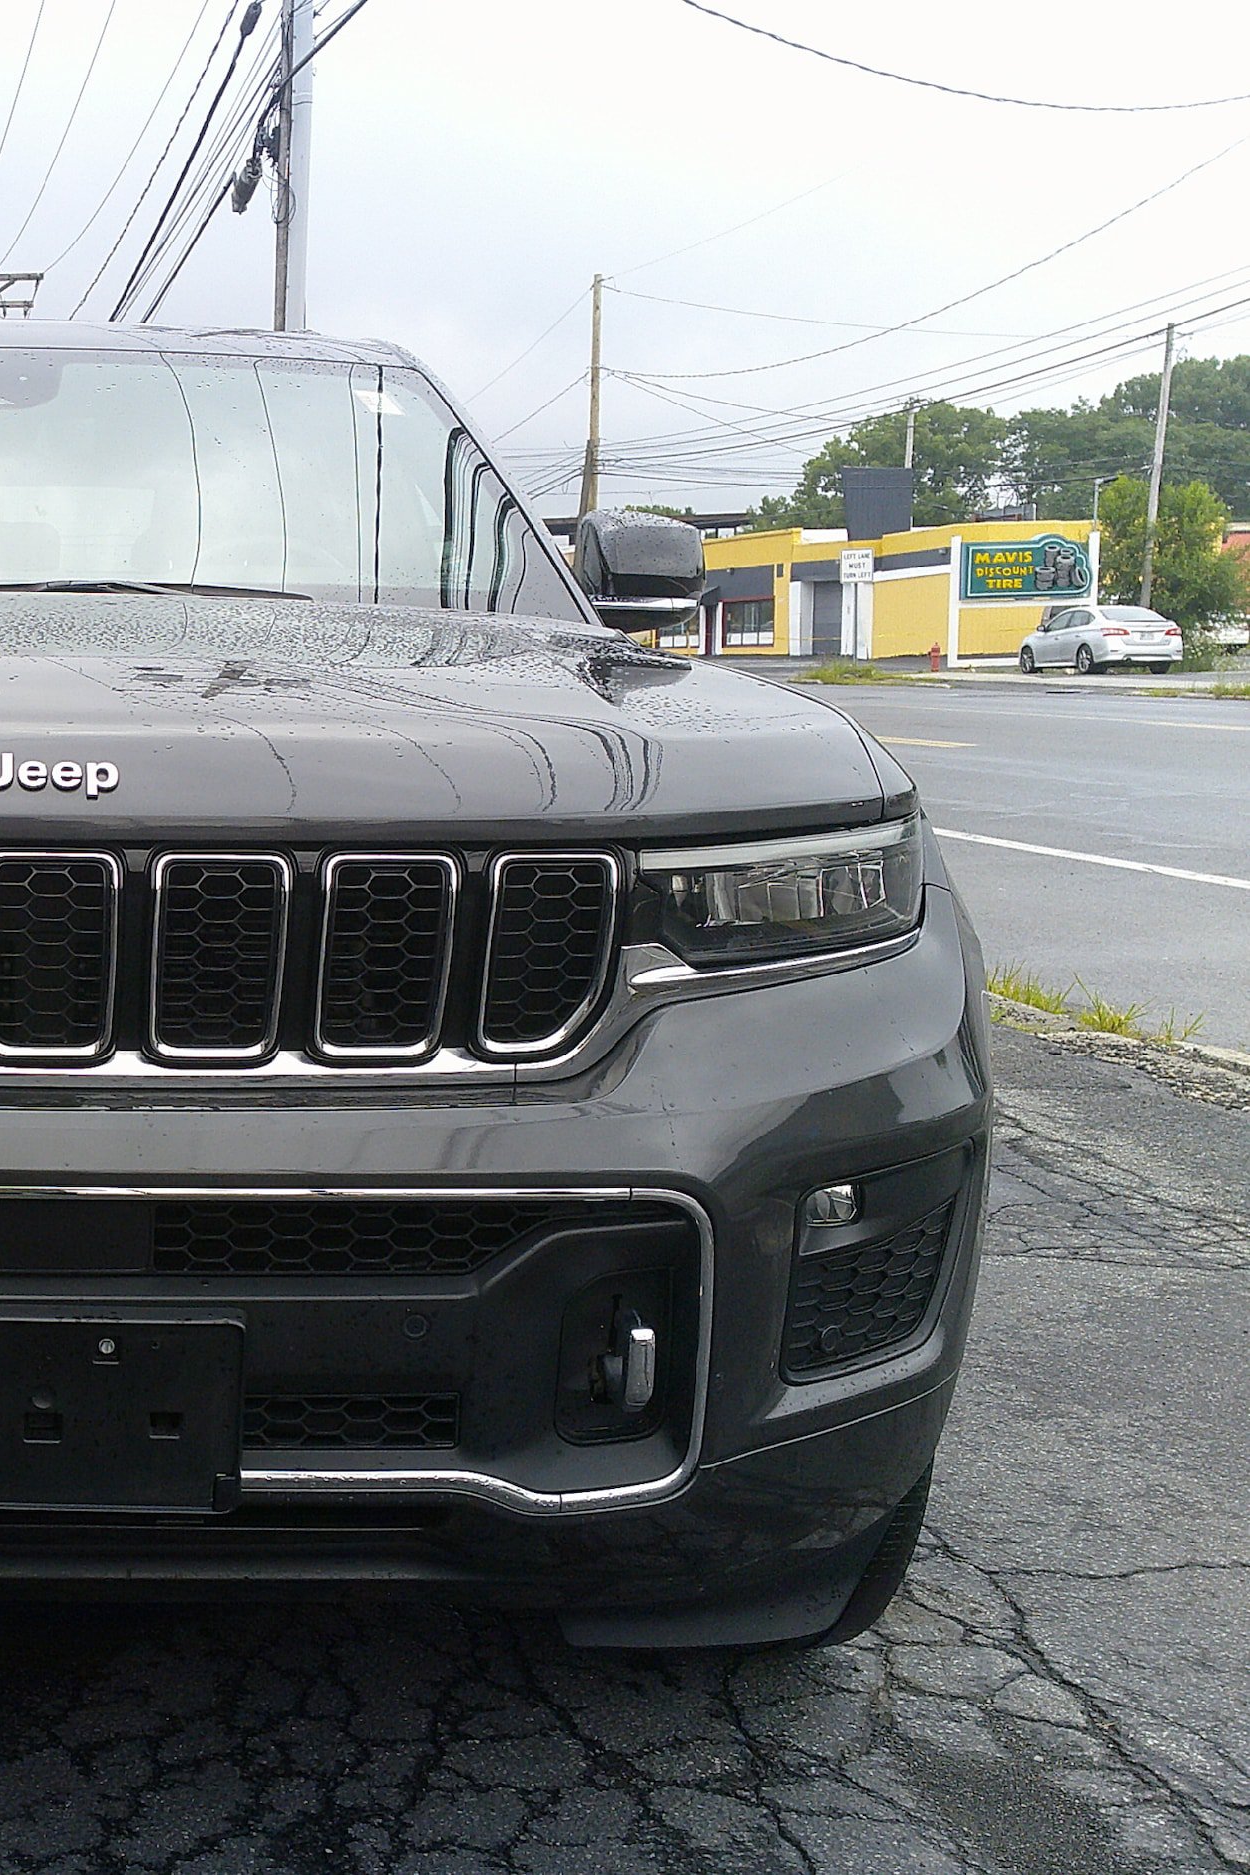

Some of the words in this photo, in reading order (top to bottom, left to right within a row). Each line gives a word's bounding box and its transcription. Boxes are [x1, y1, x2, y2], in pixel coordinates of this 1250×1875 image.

[857, 552, 870, 560] LANE
[974, 551, 1033, 564] MAVIS
[857, 571, 871, 579] LEFT
[975, 565, 1034, 578] DISCOUNT
[985, 578, 1023, 589] TIRE
